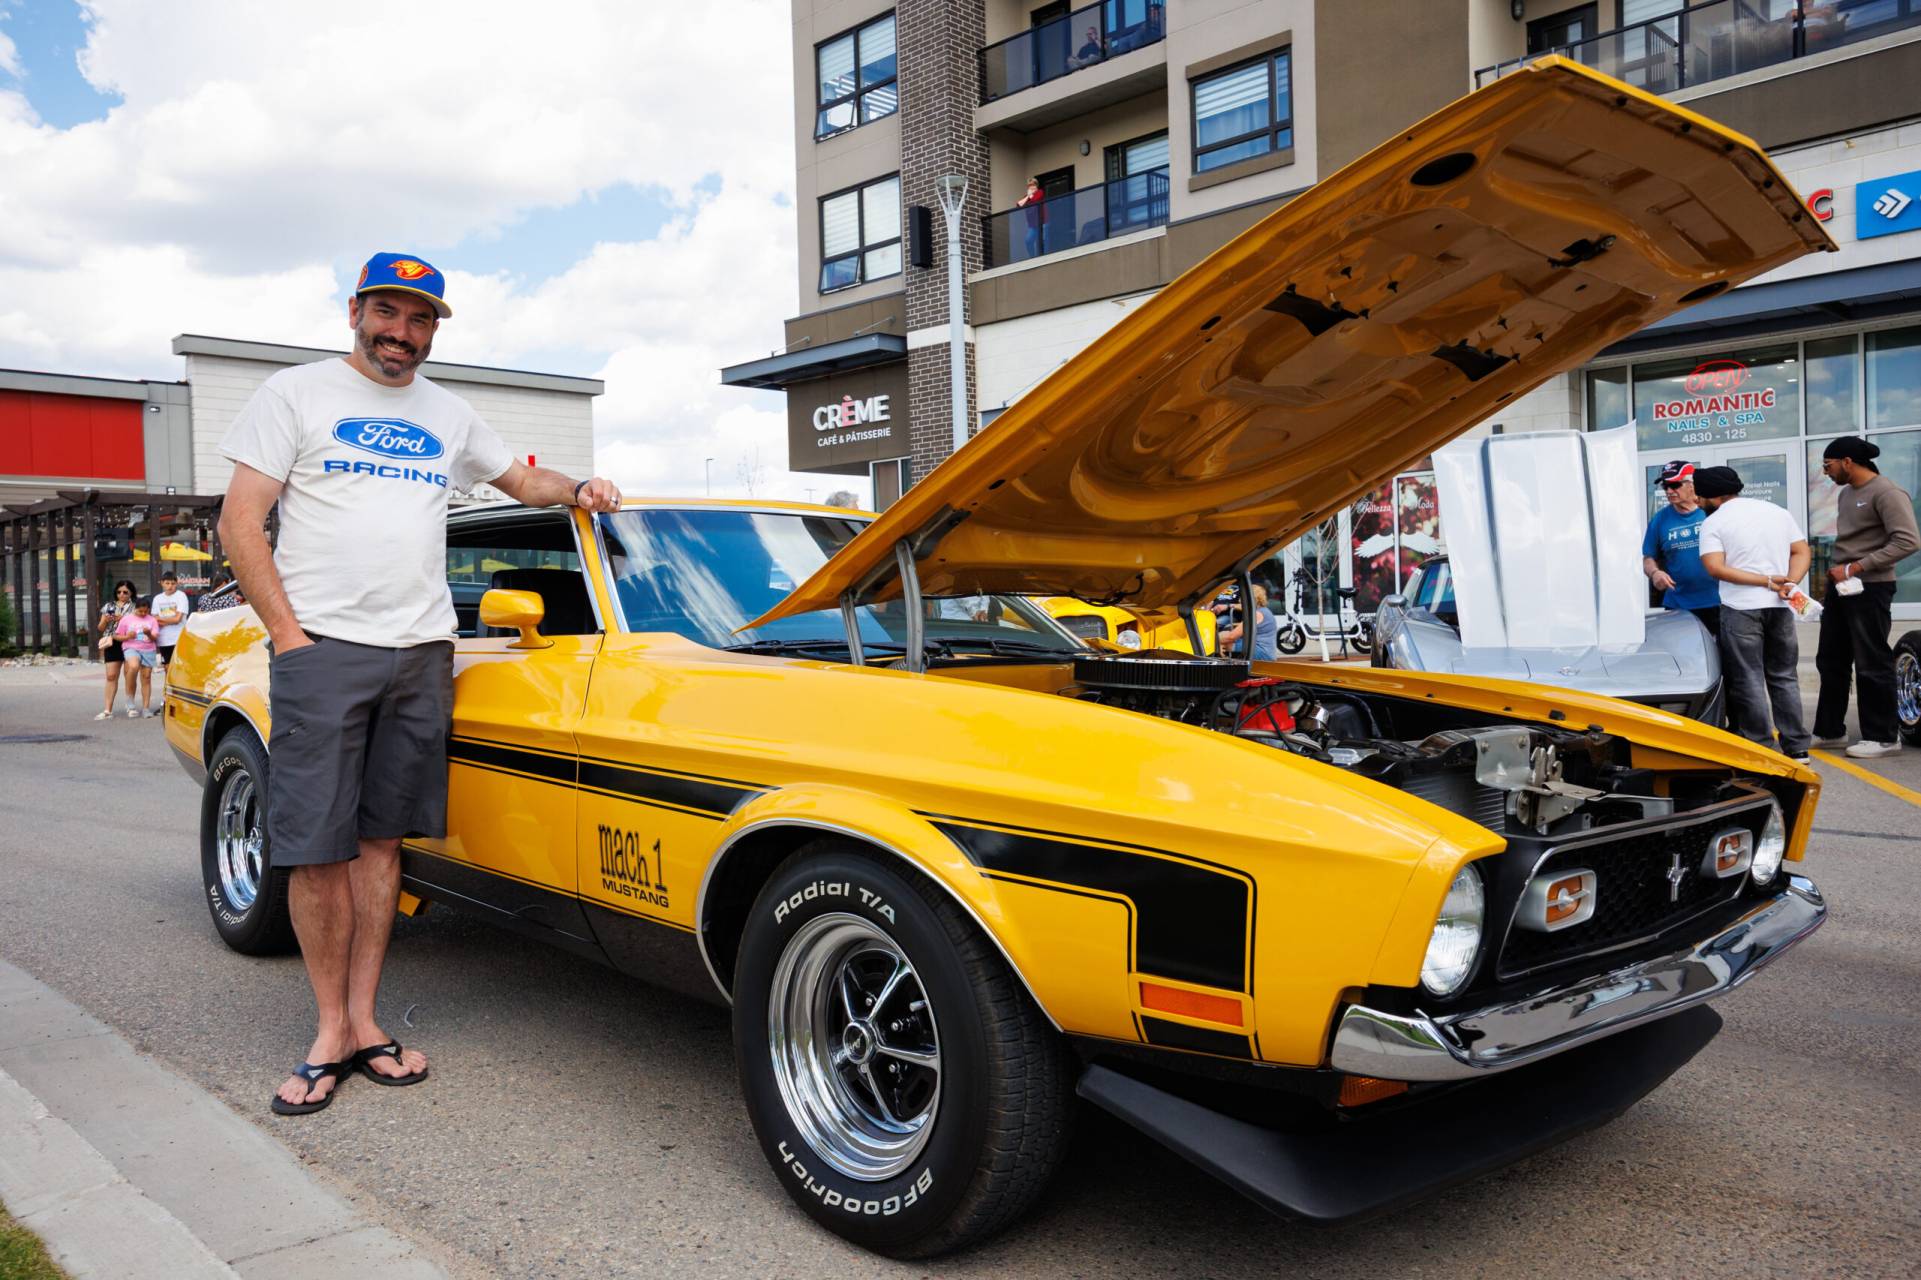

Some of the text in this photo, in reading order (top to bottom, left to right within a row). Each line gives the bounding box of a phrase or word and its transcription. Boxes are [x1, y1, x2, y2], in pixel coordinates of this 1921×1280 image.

[1687, 368, 1742, 391] OPEN
[813, 394, 891, 431] CRÈME
[1653, 389, 1775, 420] ROMANTIC
[1667, 411, 1765, 432] NAILS & SPA
[1682, 432, 1712, 444] 4830
[1725, 428, 1747, 440] 125
[358, 422, 426, 453] Ford
[817, 427, 892, 447] CAFÉ & PÂTISSERIE
[323, 460, 448, 488] RACING
[653, 838, 668, 893] 1
[602, 878, 669, 908] MUSTANG
[774, 880, 895, 925] Radial T/A
[778, 1140, 933, 1216] BFGoodrich
